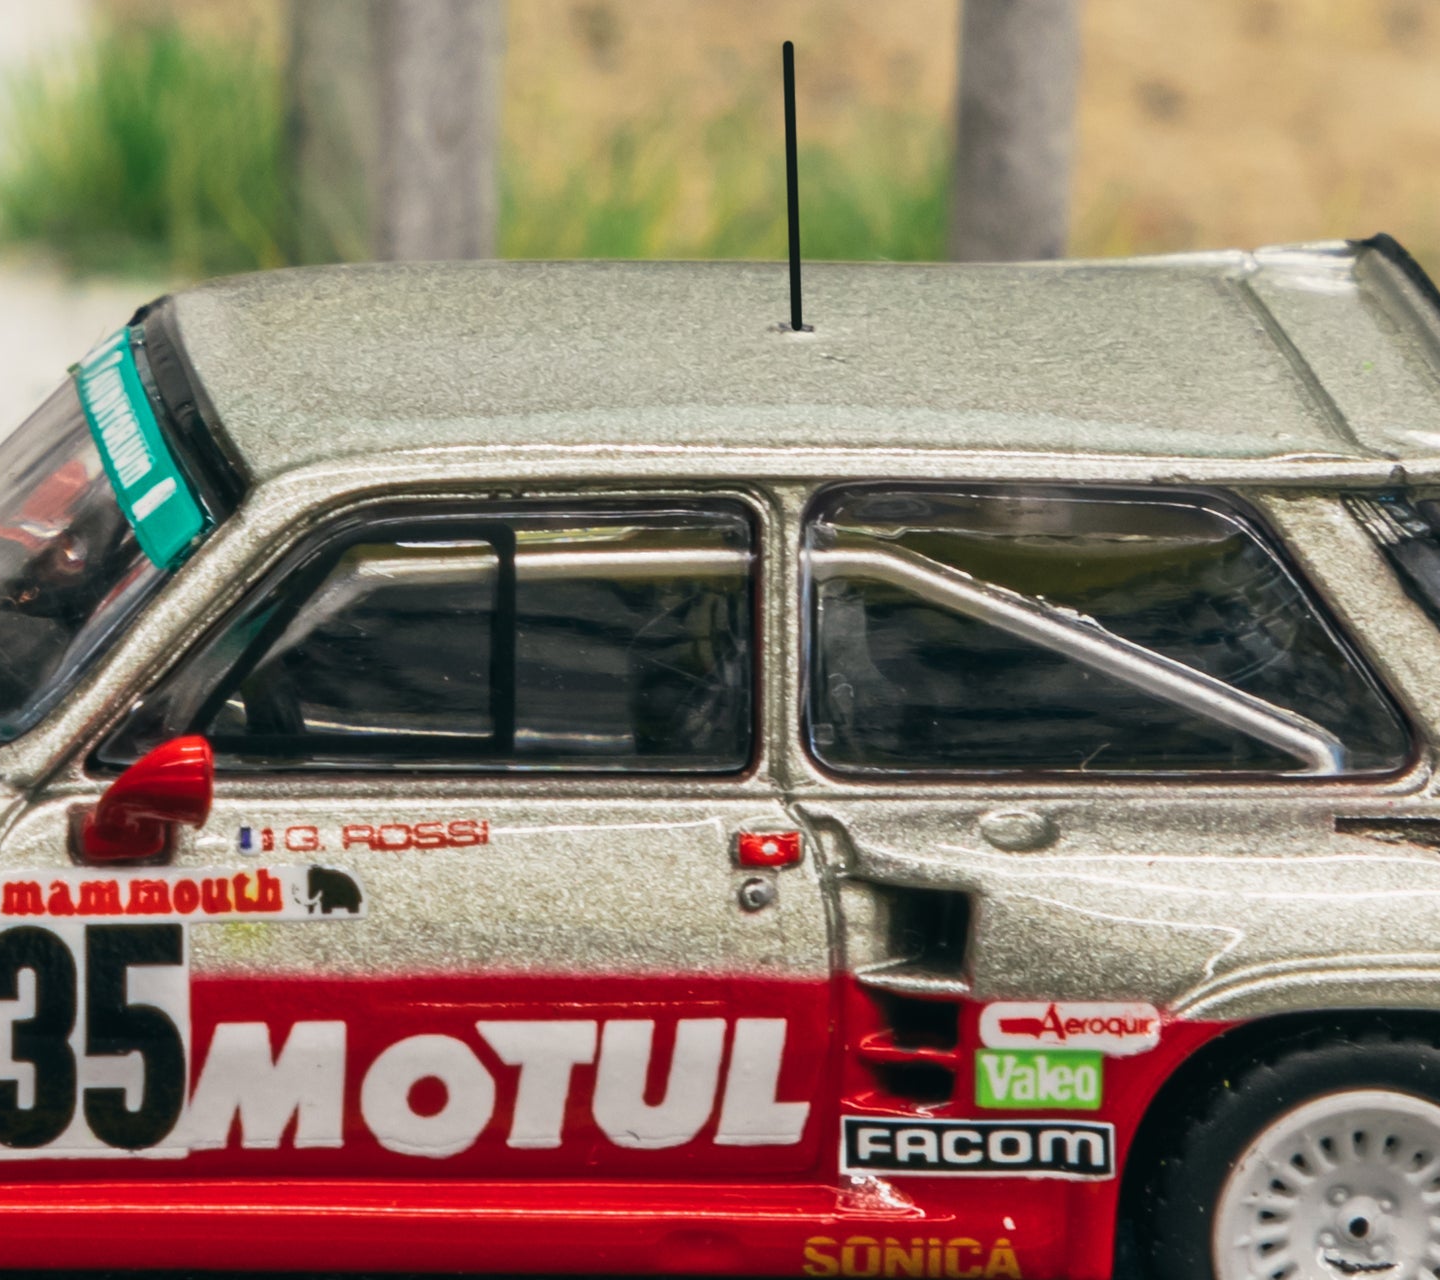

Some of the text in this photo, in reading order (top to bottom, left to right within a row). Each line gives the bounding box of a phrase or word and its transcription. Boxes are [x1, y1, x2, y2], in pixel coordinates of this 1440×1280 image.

[342, 820, 489, 851] ROSSI
[0, 868, 284, 915] mammouth
[188, 1018, 810, 1158] MOTUL
[981, 1054, 1097, 1102] Valeo
[857, 1128, 1107, 1166] FACOM
[802, 1236, 1021, 1279] SONICA
